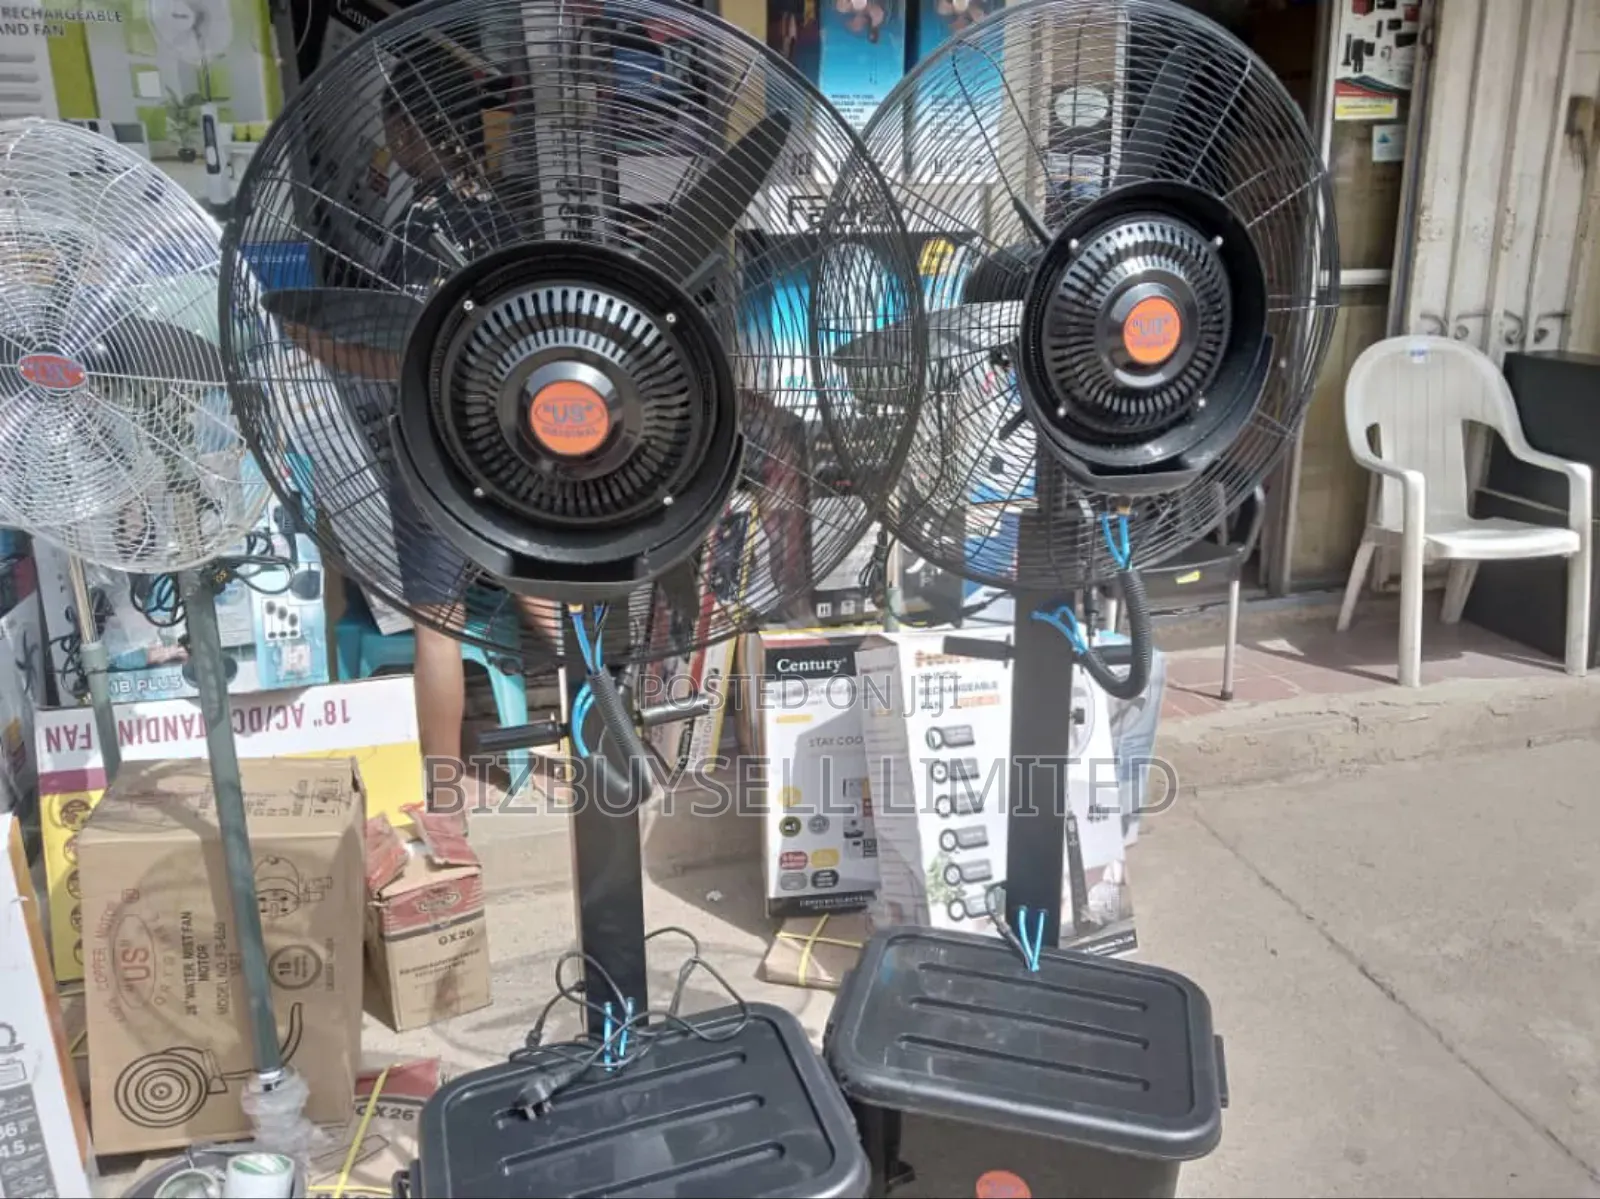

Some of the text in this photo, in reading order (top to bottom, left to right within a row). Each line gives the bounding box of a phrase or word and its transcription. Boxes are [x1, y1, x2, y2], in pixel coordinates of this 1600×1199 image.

[1, 7, 123, 22] RECHARGEABLE
[34, 24, 64, 36] FAN
[777, 658, 841, 673] Century
[232, 703, 305, 733] AC/DC
[45, 723, 93, 753] FAN
[837, 735, 865, 747] COO
[180, 911, 192, 935] FAN
[119, 938, 152, 992] "US"
[196, 944, 210, 982] MOTOR
[182, 963, 197, 1000] WATER
